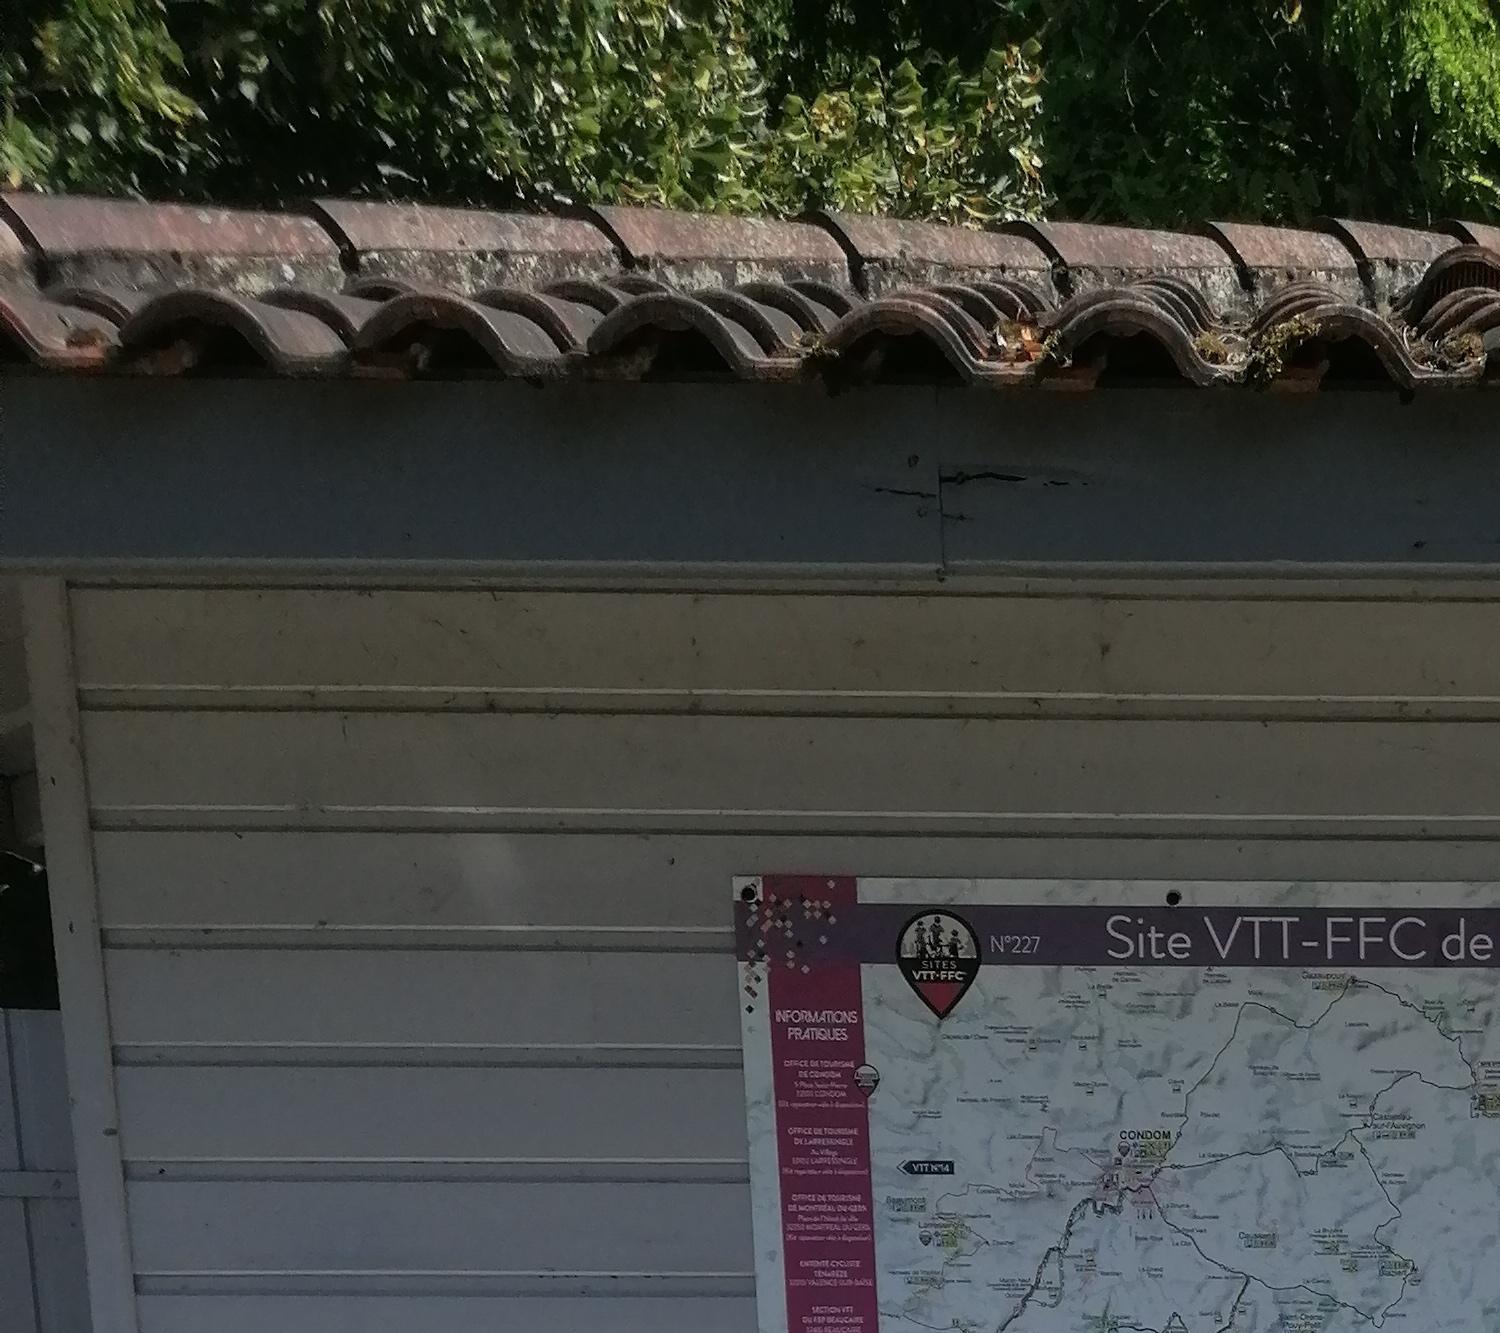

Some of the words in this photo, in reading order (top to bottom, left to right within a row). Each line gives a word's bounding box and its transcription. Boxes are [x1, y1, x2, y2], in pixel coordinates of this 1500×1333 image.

[1106, 915, 1192, 959] Site
[1203, 916, 1426, 960] VTT-FFC
[1442, 917, 1493, 960] de
[990, 936, 1040, 953] N°227
[921, 960, 957, 969] SITES
[776, 1010, 858, 1024] INFORMATIONS
[788, 1028, 848, 1041] PRATIQUES
[1120, 1131, 1171, 1140] CONDOM
